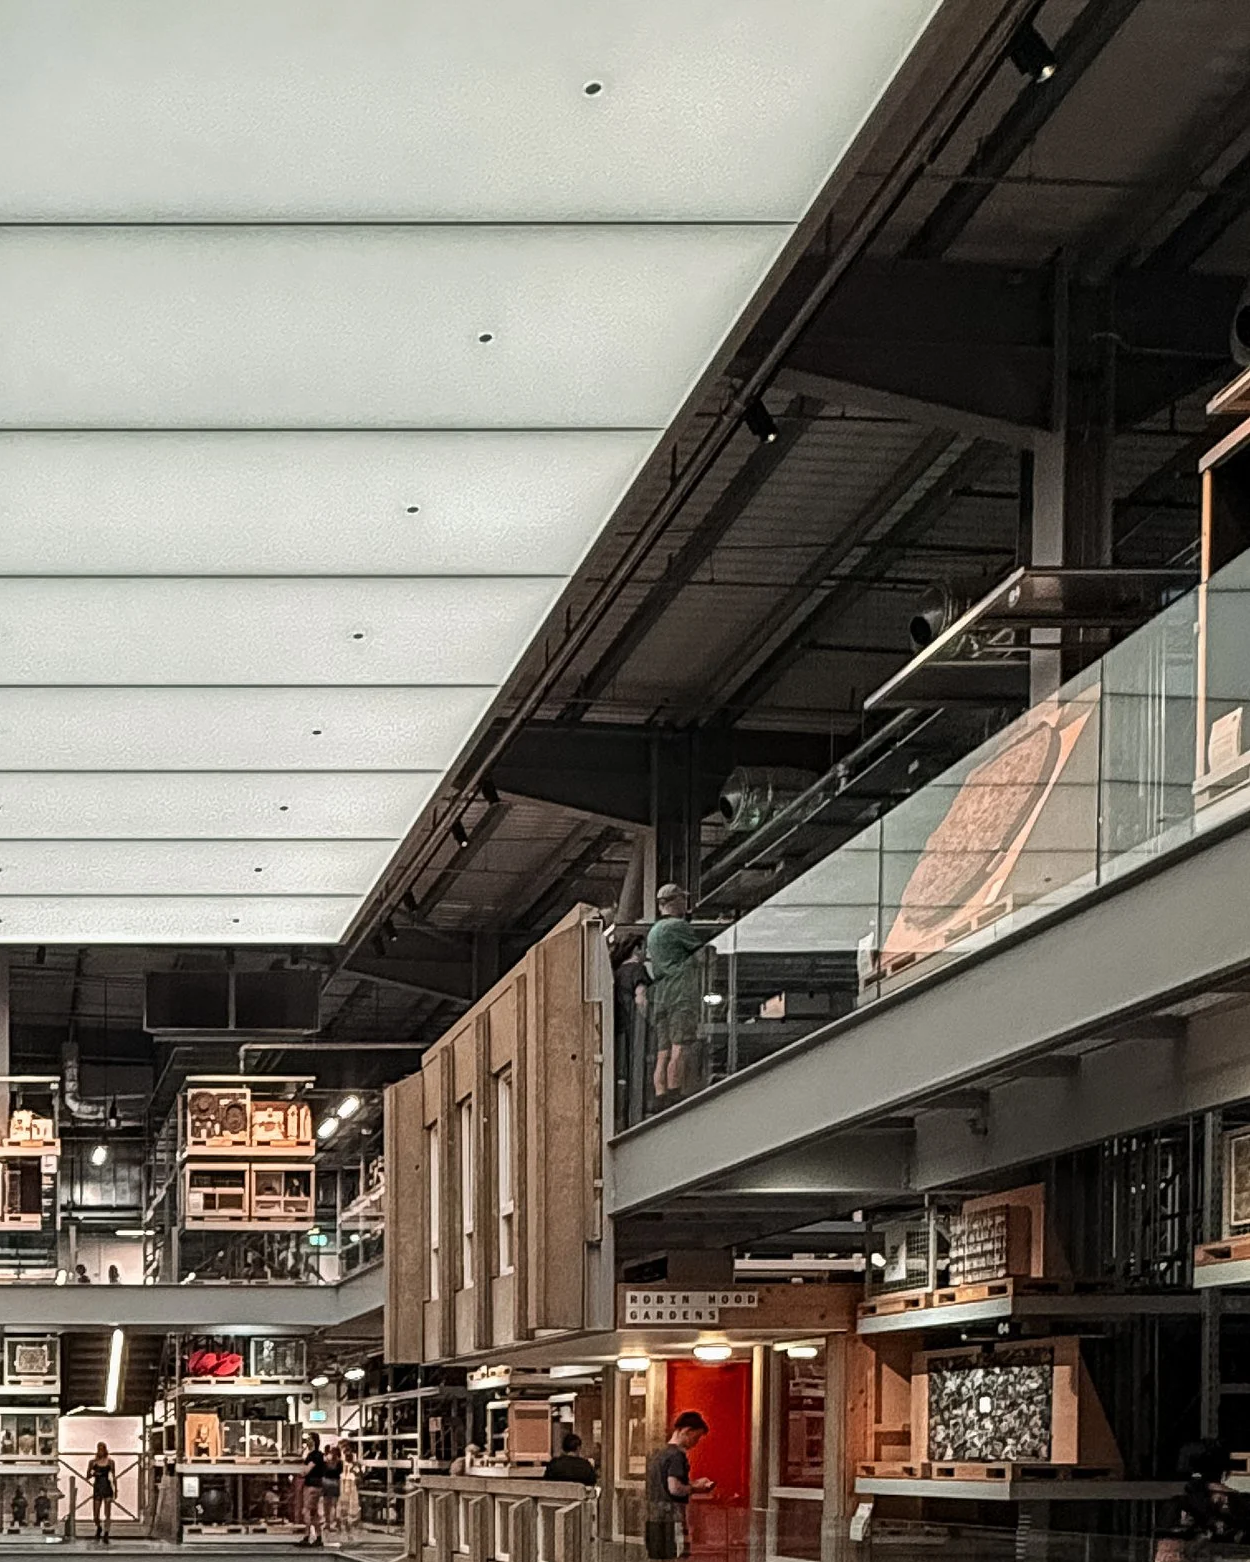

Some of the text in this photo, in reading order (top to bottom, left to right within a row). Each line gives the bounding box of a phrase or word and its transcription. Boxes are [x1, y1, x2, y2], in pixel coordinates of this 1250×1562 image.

[630, 1294, 756, 1305] ROBIN HOOD
[630, 1310, 716, 1321] GARDENS
